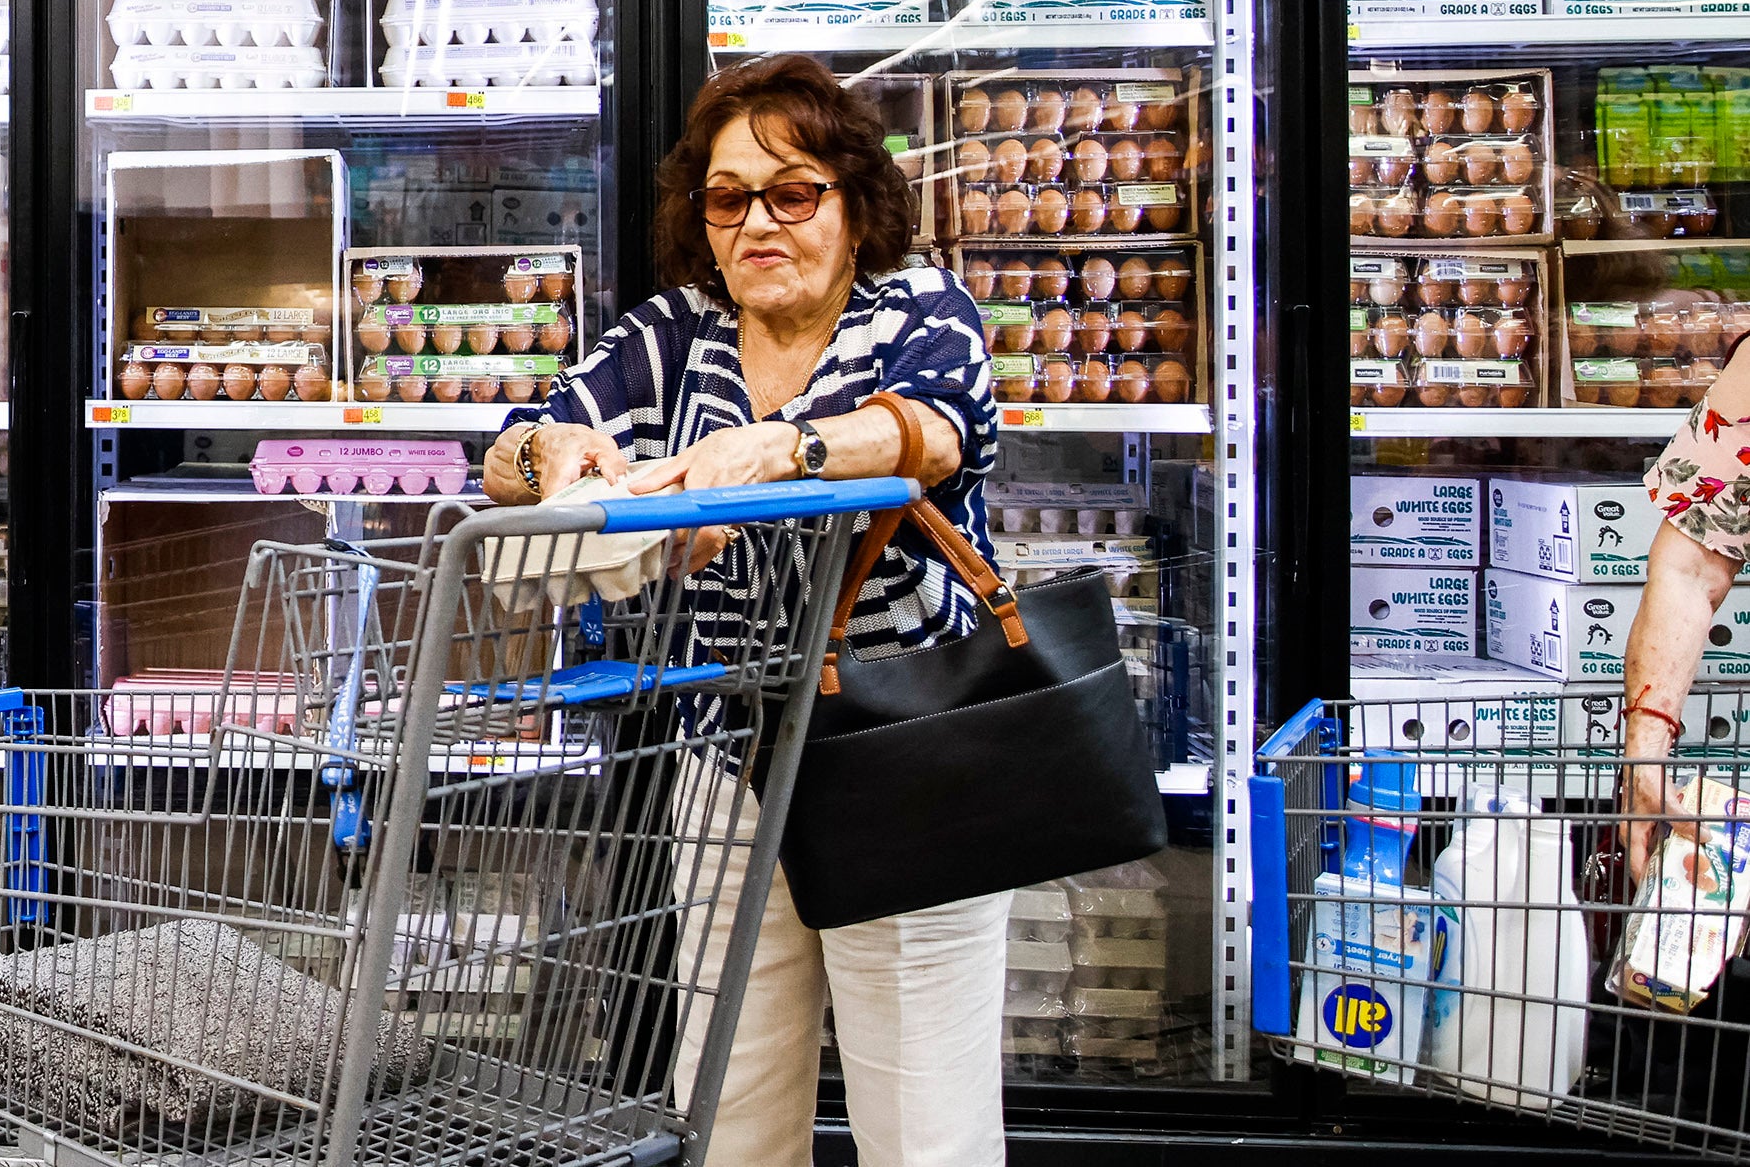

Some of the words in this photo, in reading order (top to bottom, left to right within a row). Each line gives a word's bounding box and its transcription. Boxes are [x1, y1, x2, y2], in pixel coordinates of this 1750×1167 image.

[1110, 9, 1145, 20] GRADE
[1149, 9, 1156, 19] A
[1180, 8, 1206, 19] EGGS
[1441, 4, 1477, 15] GRADE
[1481, 4, 1488, 14] A
[1509, 4, 1537, 14] EGGS
[1567, 5, 1581, 14] 60
[1586, 5, 1613, 14] EGGS
[1701, 4, 1738, 13] GRADE
[895, 14, 921, 23] EGGS
[982, 11, 997, 22] 60
[1001, 11, 1026, 22] EGGS
[274, 311, 281, 319] 12
[385, 309, 410, 318] Organic
[423, 308, 438, 319] 12
[386, 360, 410, 369] Organic
[423, 359, 438, 370] 12
[339, 448, 349, 456] 12
[351, 448, 384, 456] JUMBO
[1433, 486, 1473, 499] LARGE
[1396, 501, 1439, 513] WHITE
[1443, 501, 1473, 514] EGGS
[1597, 505, 1620, 514] Great
[1380, 547, 1415, 558] GRADE
[1418, 548, 1426, 558] A
[1447, 549, 1473, 559] EGGS
[1593, 564, 1608, 576] 60
[1611, 564, 1640, 576] EGGS
[1429, 578, 1469, 591] LARGE
[1392, 592, 1435, 605] WHITE
[1438, 593, 1469, 605] EGGS
[1586, 603, 1609, 612] Great
[1377, 639, 1411, 650] GRADE
[1414, 639, 1421, 650] A
[1443, 640, 1469, 651] EGGS
[1582, 663, 1597, 674] 60
[1334, 995, 1387, 1036] all
